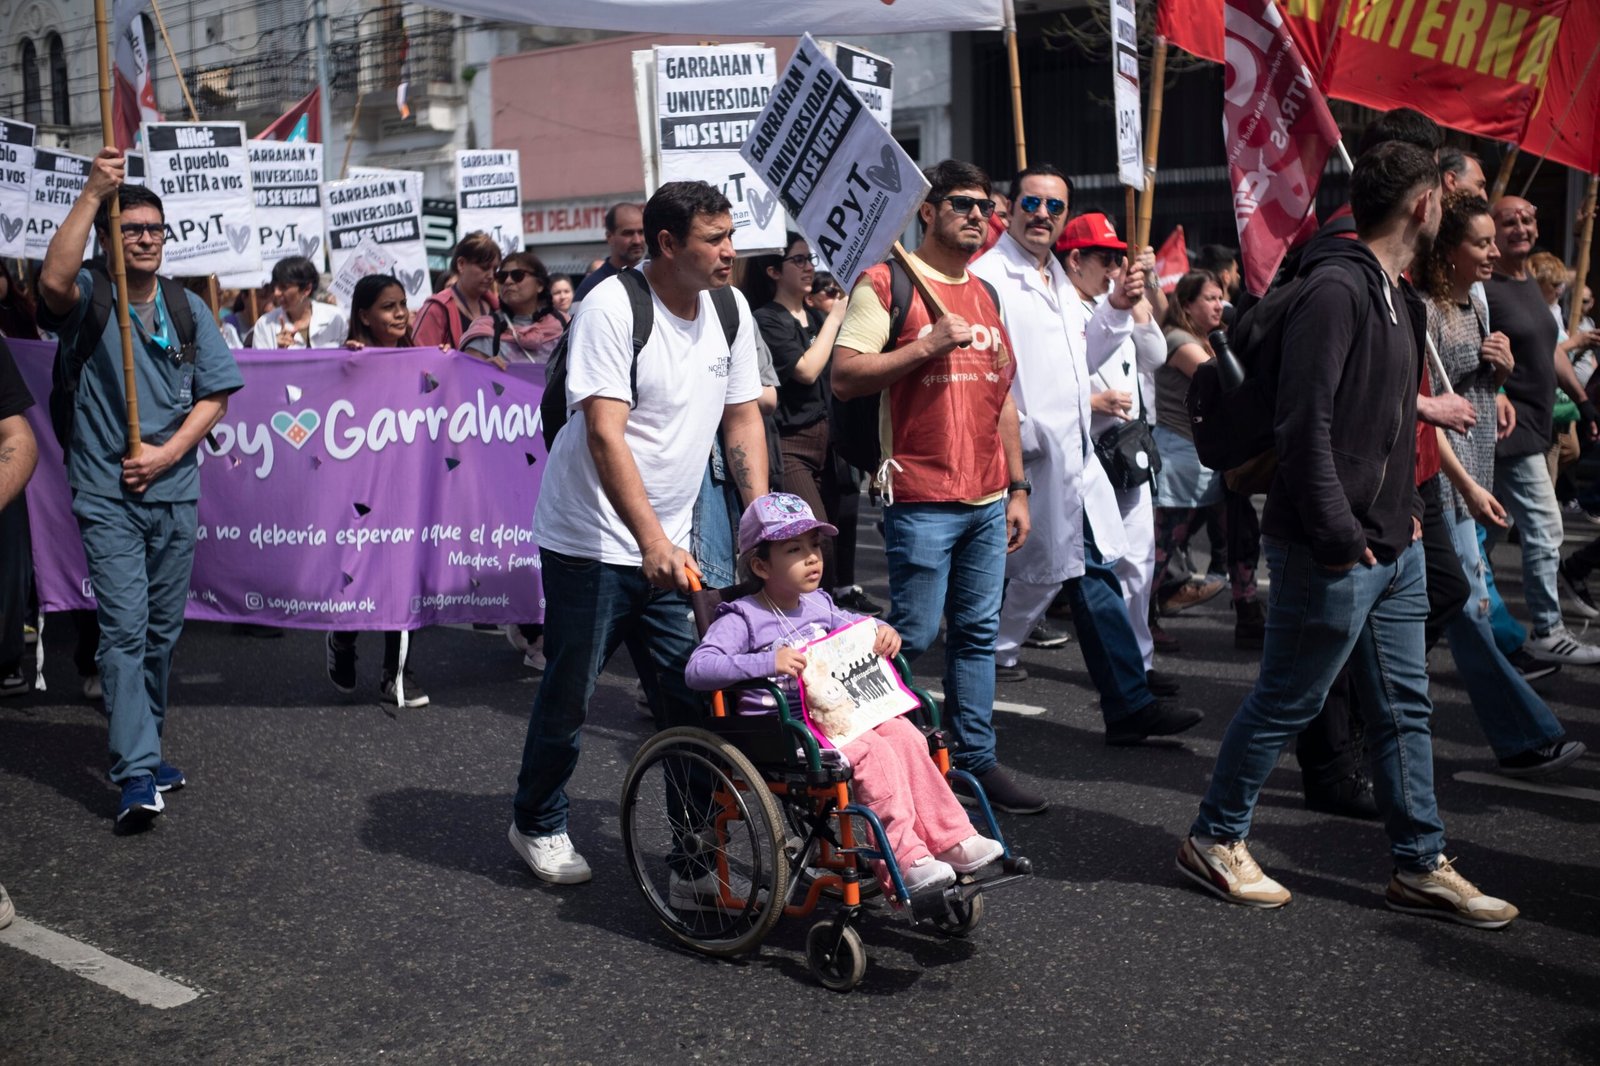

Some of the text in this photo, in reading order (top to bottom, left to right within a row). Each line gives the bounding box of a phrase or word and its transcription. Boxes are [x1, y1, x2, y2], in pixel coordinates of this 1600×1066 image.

[666, 53, 765, 79] GARRAHAN Y
[667, 86, 769, 113] UNIVERSIDAD
[750, 47, 812, 163] GARRAHAN Y
[175, 126, 216, 149] Milei:
[719, 119, 756, 143] VET
[767, 68, 833, 187] UNIVERSIDAD
[811, 94, 852, 158] VETAN
[169, 150, 229, 173] el pueblo
[309, 148, 316, 160] Y
[6, 168, 26, 184] vos
[45, 175, 55, 187] el
[161, 174, 243, 195] te VETA a vos
[35, 188, 46, 202] te
[47, 190, 71, 205] VETA
[329, 179, 407, 205] GARRAHAN Y
[332, 200, 413, 226] UNIVERSIDAD
[523, 210, 544, 234] EN
[817, 162, 871, 267] APyT
[26, 218, 59, 235] AP
[163, 213, 223, 243] APyT
[259, 223, 298, 249] PyT
[837, 235, 860, 278] Hospital
[858, 190, 884, 237] Garrahan
[197, 388, 544, 480] oy Garrahan
[216, 525, 241, 541] no
[249, 522, 327, 550] debería
[335, 526, 415, 552] esperar
[430, 523, 462, 547] que
[469, 524, 485, 546] el
[491, 523, 533, 549] dolor
[448, 551, 502, 571] Madres,
[267, 597, 376, 614] soygarrahan.ok
